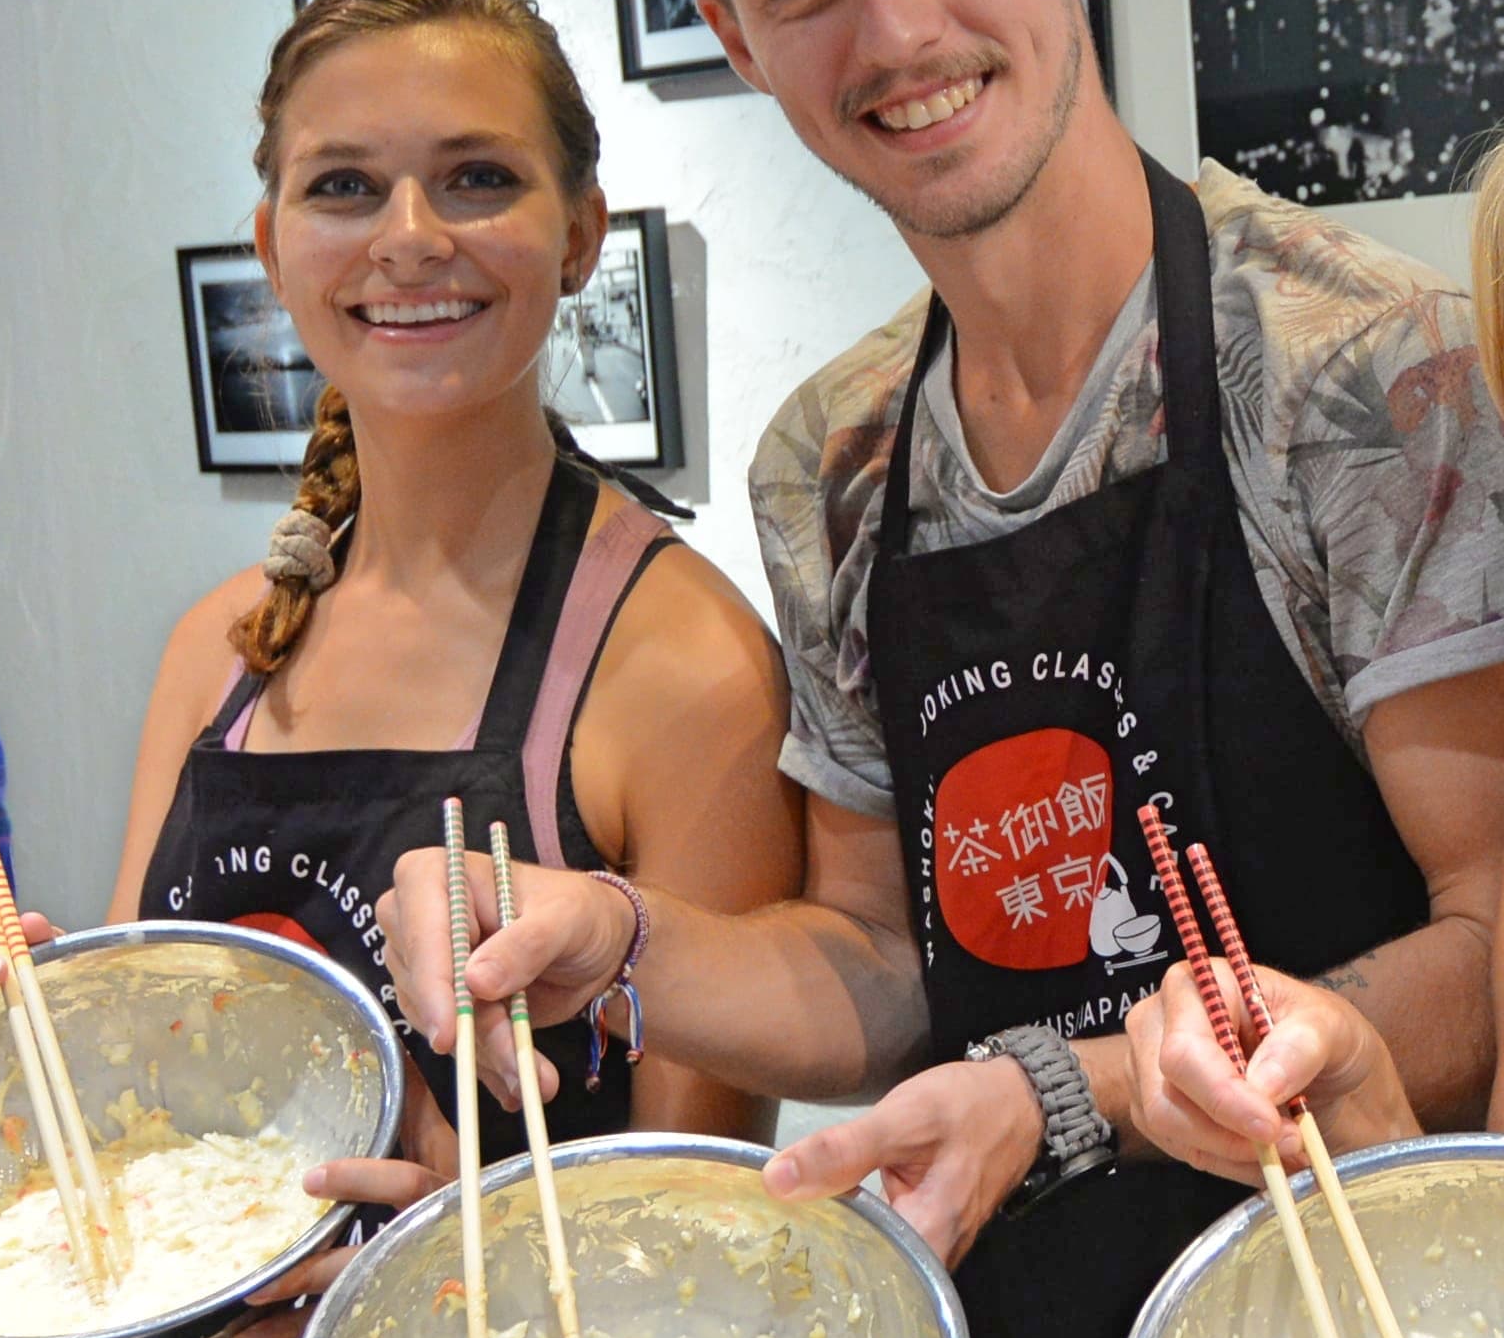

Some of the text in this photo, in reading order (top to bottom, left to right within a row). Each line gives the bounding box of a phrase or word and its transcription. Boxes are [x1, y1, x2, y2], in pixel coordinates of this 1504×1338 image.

[1132, 750, 1158, 776] &
[942, 772, 1107, 877] 茶御飯
[995, 853, 1099, 930] 東京
